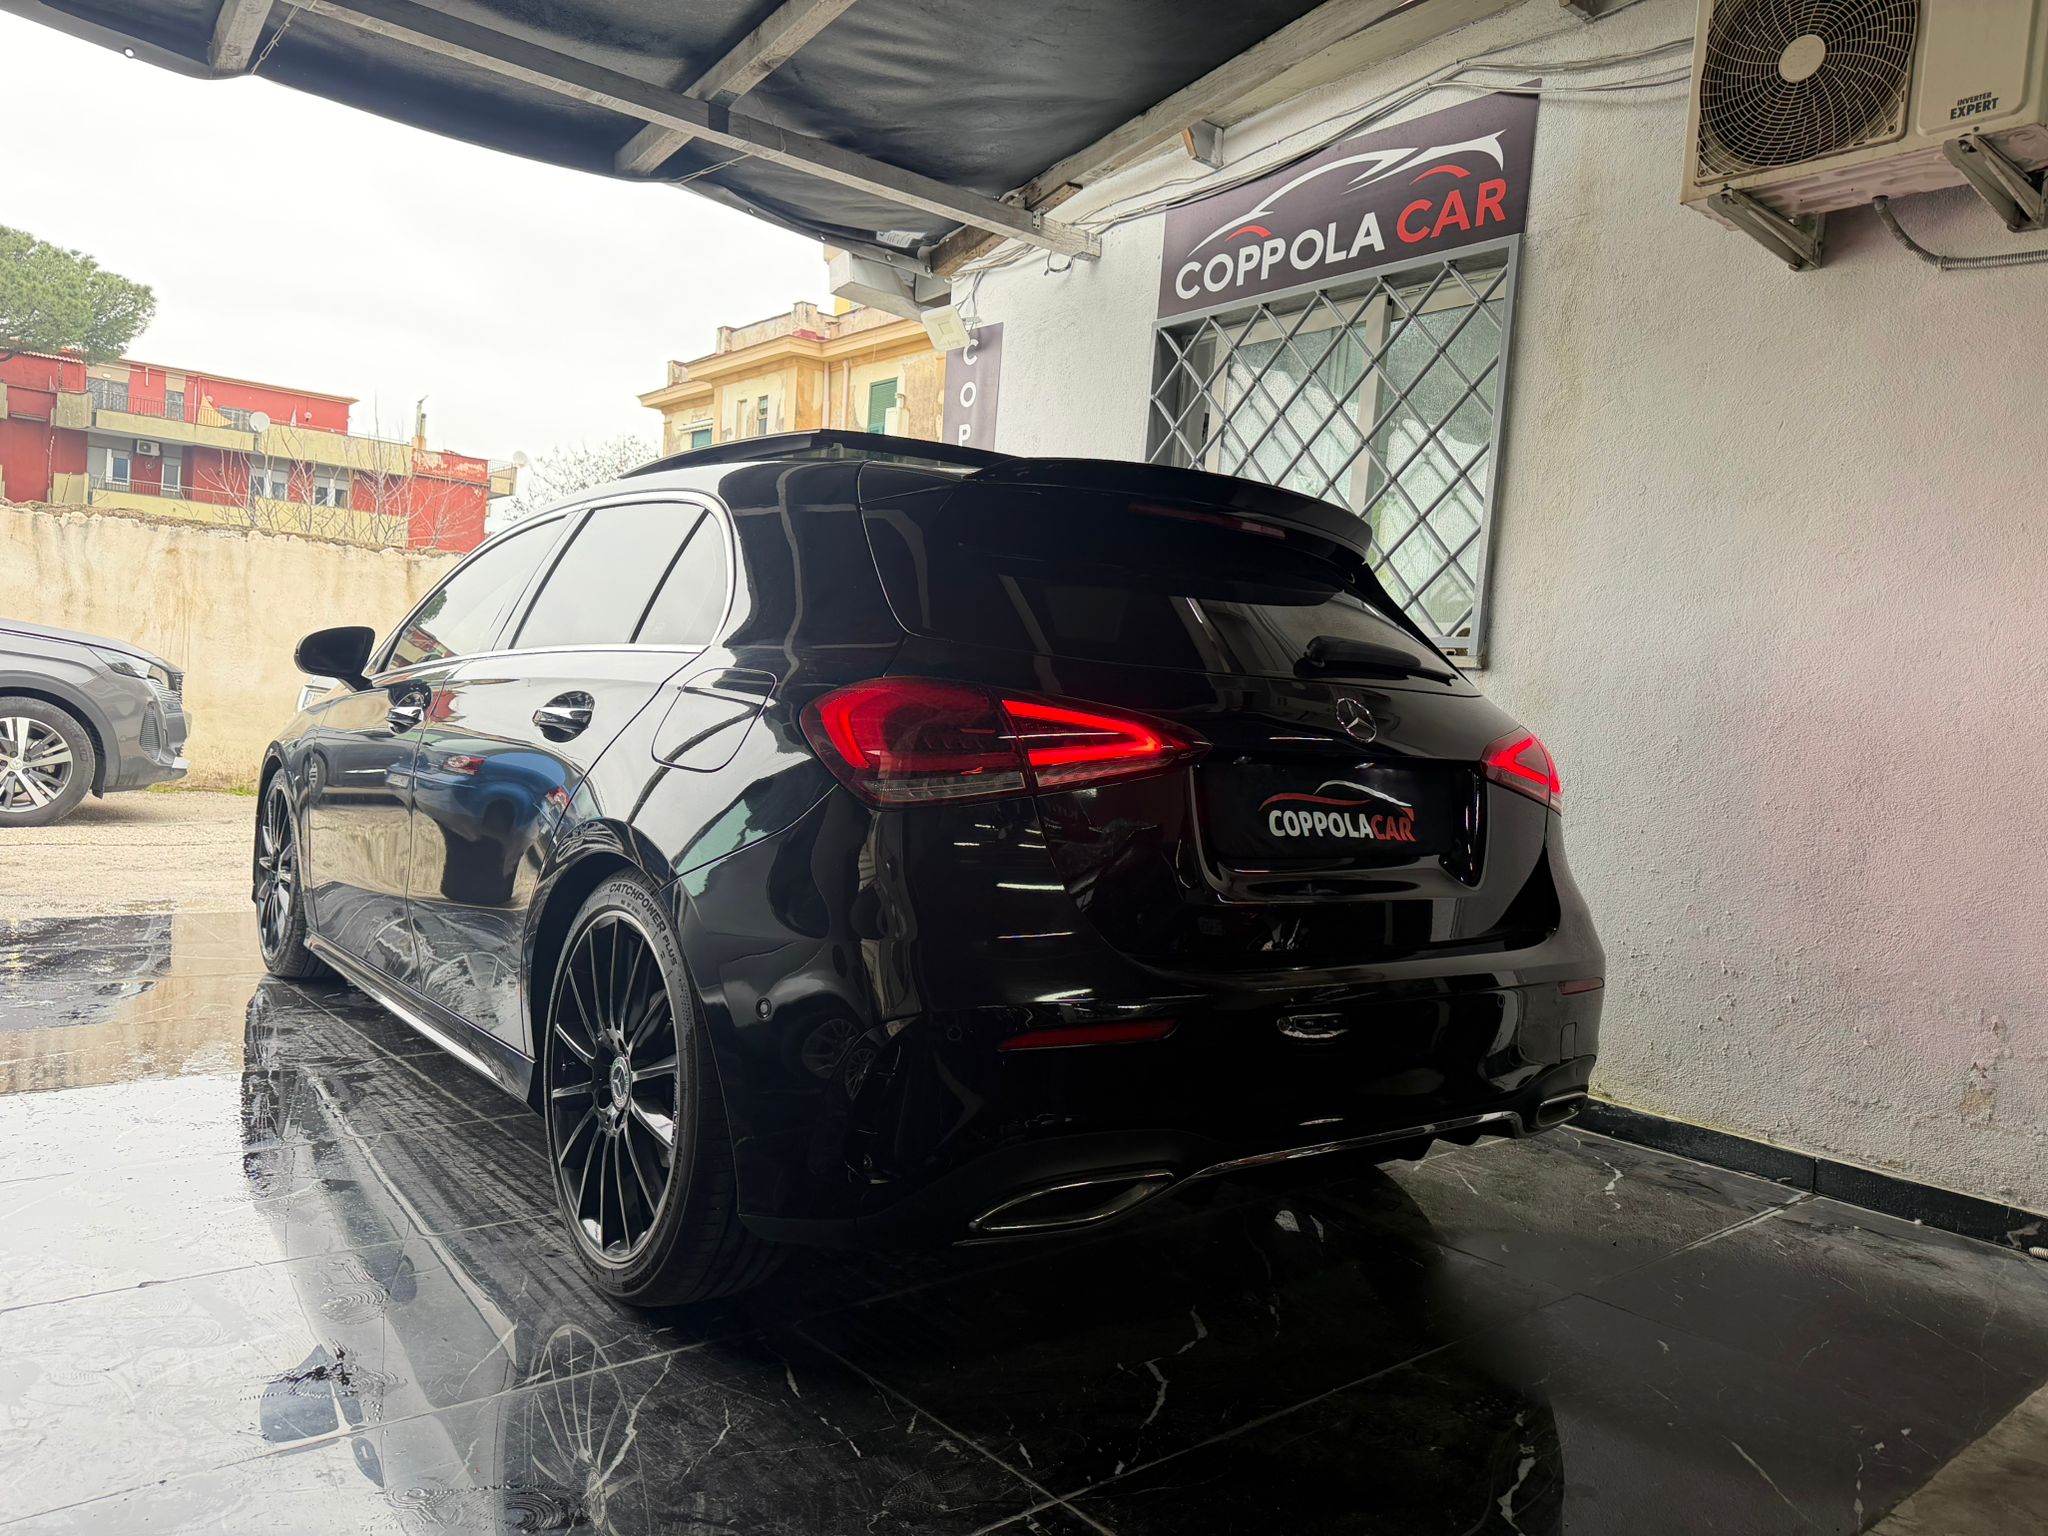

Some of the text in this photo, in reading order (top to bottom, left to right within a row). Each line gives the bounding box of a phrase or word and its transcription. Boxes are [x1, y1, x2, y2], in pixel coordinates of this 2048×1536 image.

[1950, 97, 1999, 120] EXPERT
[1957, 92, 1992, 106] INVERTER
[1175, 178, 1507, 299] COPPOLA CAR
[609, 883, 667, 933] CATCHPOWER
[663, 935, 678, 966] PLUS
